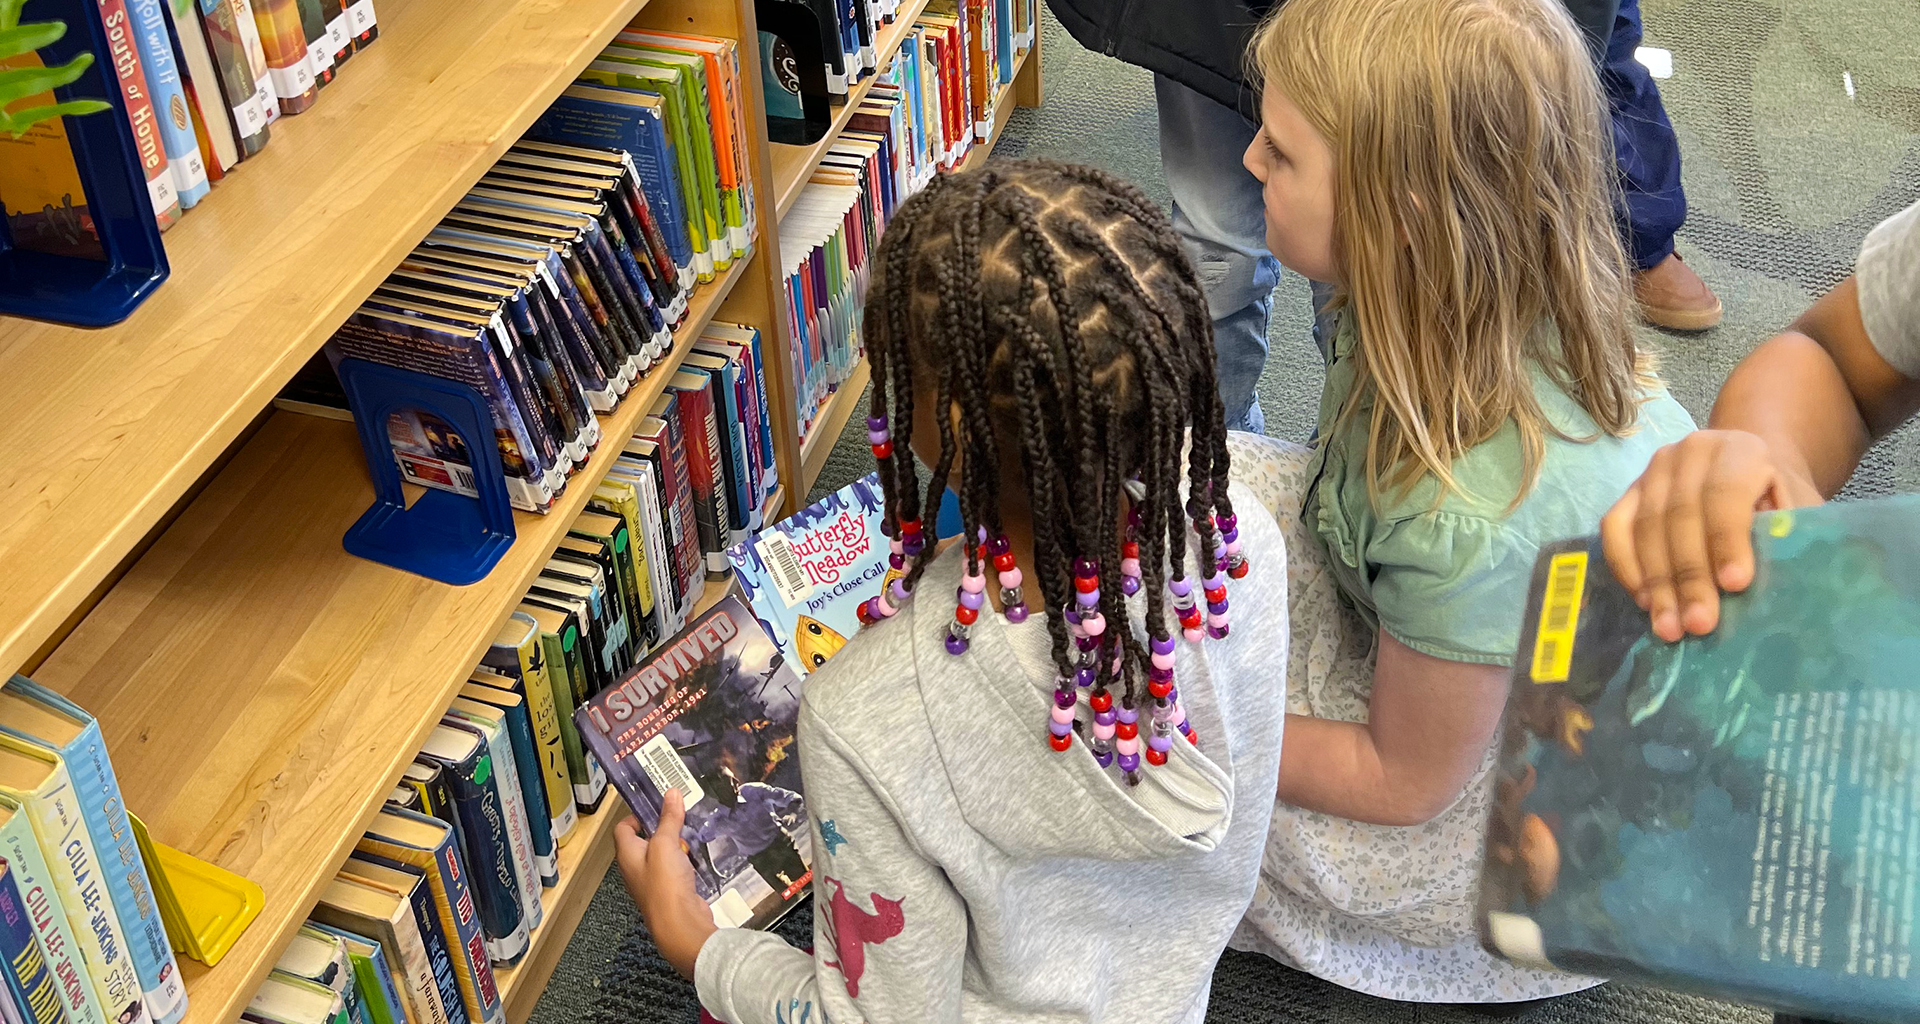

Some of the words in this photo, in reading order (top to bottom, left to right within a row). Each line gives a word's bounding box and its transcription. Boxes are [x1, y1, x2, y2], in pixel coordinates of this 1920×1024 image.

[106, 10, 134, 79] South
[148, 32, 170, 67] with
[159, 69, 175, 84] It
[127, 85, 143, 100] of
[132, 104, 160, 168] Home
[704, 413, 719, 459] HANDLE
[711, 461, 722, 484] THE
[806, 591, 833, 614] Joy's
[833, 576, 862, 596] Close
[863, 562, 885, 580] Call
[589, 706, 612, 734] I
[606, 611, 738, 722] SURVIVED
[613, 736, 644, 763] PEARL
[643, 709, 684, 739] HARBOR,
[684, 688, 707, 707] 1941
[616, 728, 636, 744] THE
[636, 696, 676, 730] BOMBING
[677, 686, 689, 699] OF
[55, 798, 65, 816] SUSAN
[508, 805, 523, 842] CROOKED
[102, 796, 121, 842] CILLA
[116, 836, 151, 920] LEE-JENKINS
[481, 791, 502, 841] GHOSTS
[493, 842, 513, 888] TUPELO
[515, 842, 528, 862] KIND
[522, 860, 530, 871] OF
[65, 839, 91, 886] CILLA
[81, 876, 118, 965] LEE-JENKINS
[420, 897, 433, 931] Thompson
[12, 932, 44, 989] THE
[26, 886, 53, 933] CILLA
[44, 926, 86, 1011] LEE-JENKINS
[429, 935, 440, 956] THE
[456, 889, 475, 925] TITO
[469, 931, 497, 1007] BONECRUSHER
[104, 969, 128, 1008] STORY
[122, 970, 137, 995] EPIC
[420, 972, 427, 981] a
[433, 950, 458, 1012] GOLDFISH
